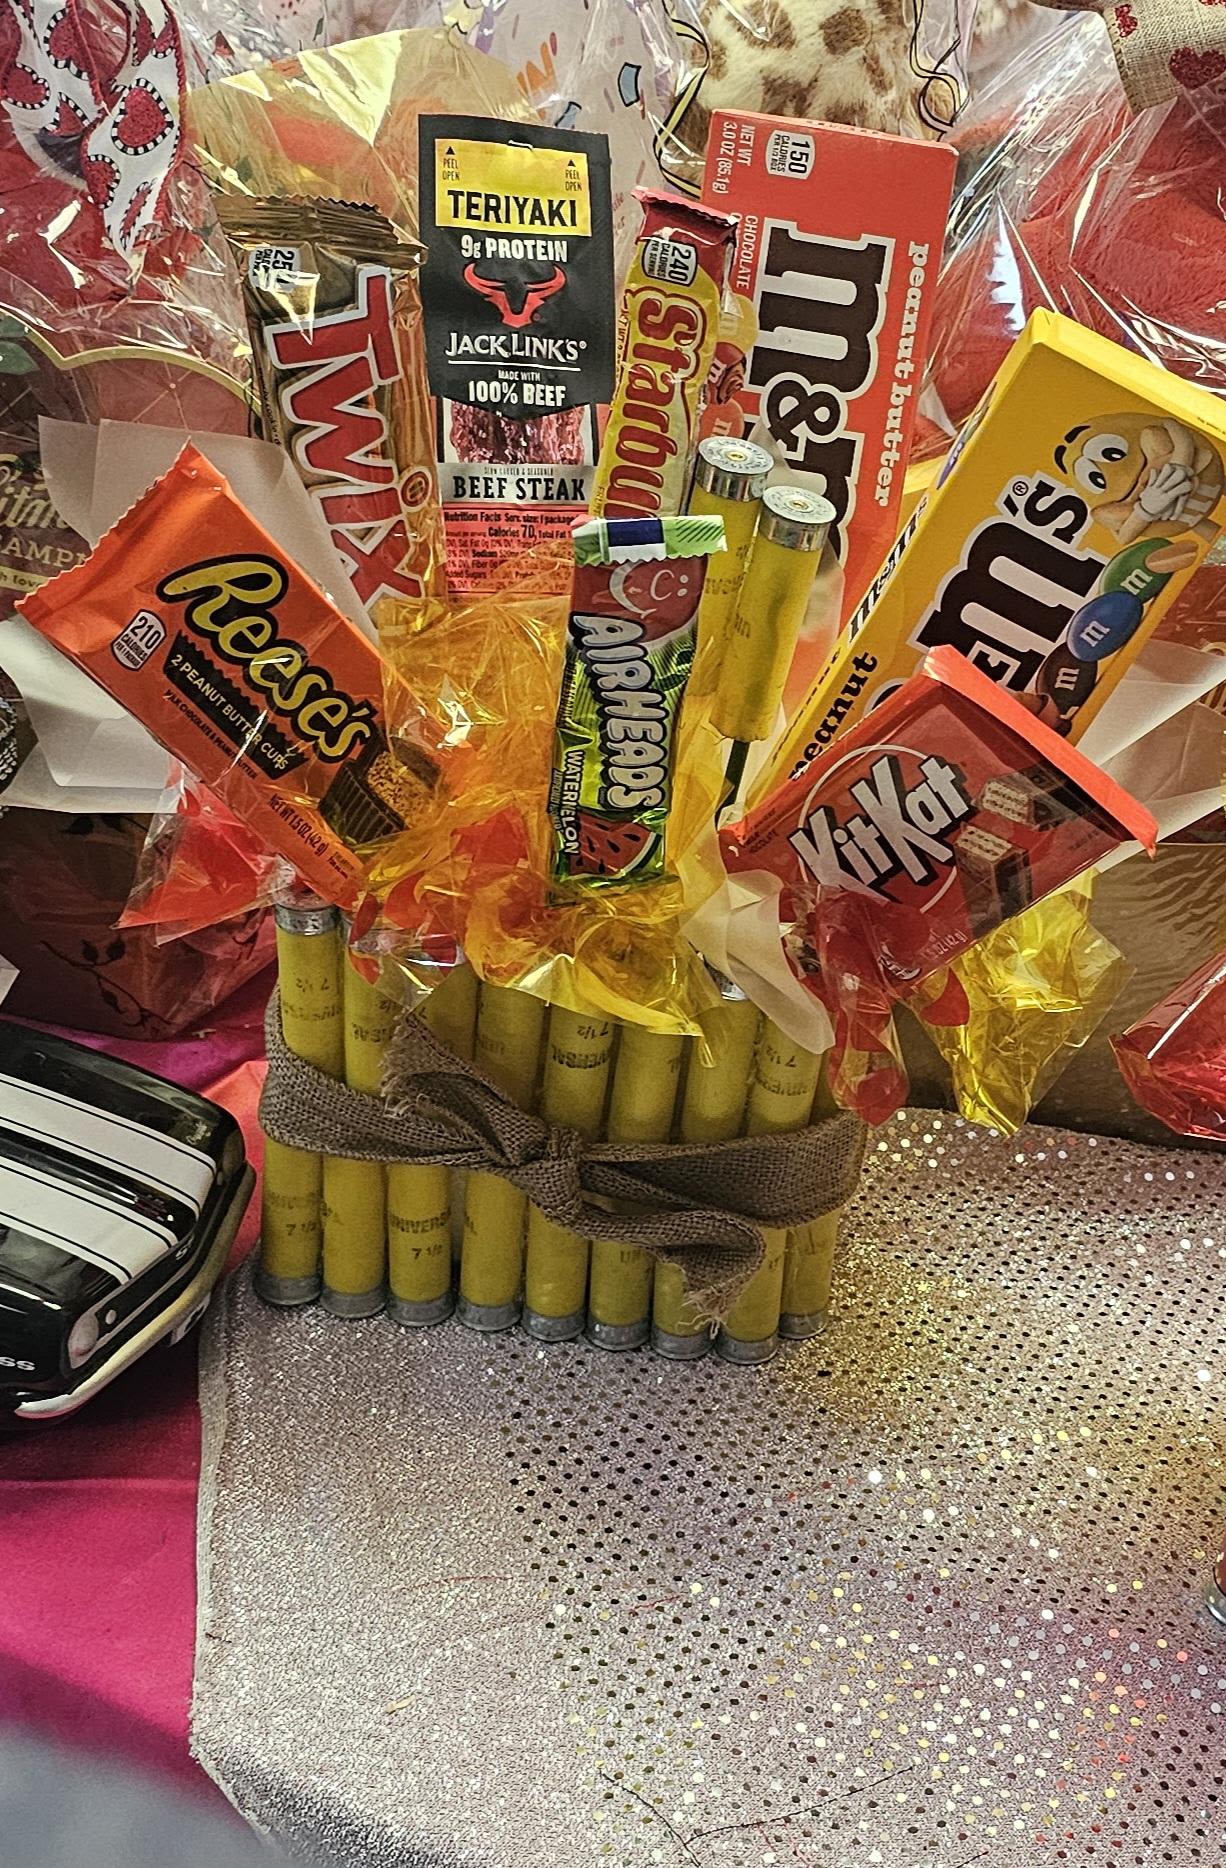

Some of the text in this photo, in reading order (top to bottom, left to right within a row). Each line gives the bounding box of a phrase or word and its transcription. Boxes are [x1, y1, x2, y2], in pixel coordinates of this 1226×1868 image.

[711, 121, 738, 195] 3.0 OZ (85.1g)
[737, 124, 756, 166] NET WT
[776, 135, 790, 173] CALORIES
[789, 140, 810, 174] 150
[442, 170, 460, 181] OPEN
[443, 158, 458, 169] PEEL
[565, 170, 580, 180] PEEL
[565, 181, 582, 191] OPEN
[447, 189, 577, 227] TERIYAKI
[461, 235, 568, 263] 9g PROTEIN
[656, 242, 671, 278] CALORIES
[668, 245, 692, 283] 240
[736, 215, 758, 289] CHOCOLATE
[445, 332, 511, 358] JACK
[498, 369, 541, 382] MADE WITH
[874, 241, 930, 507] peanut butter
[468, 381, 567, 407] 100% BEEF
[269, 266, 427, 609] TWIX
[453, 475, 586, 501] BEEF STEAK
[480, 511, 501, 523] Facts
[488, 526, 520, 538] Calories
[120, 633, 149, 661] CALORIES
[129, 614, 161, 650] 210
[1079, 619, 1111, 648] m
[159, 557, 375, 762] Reese's
[1053, 666, 1080, 691] m
[170, 653, 288, 771] 2 PEANUT BUTTER CUPS
[573, 615, 668, 810] AIRHEADS
[563, 750, 585, 855] WATERMELON
